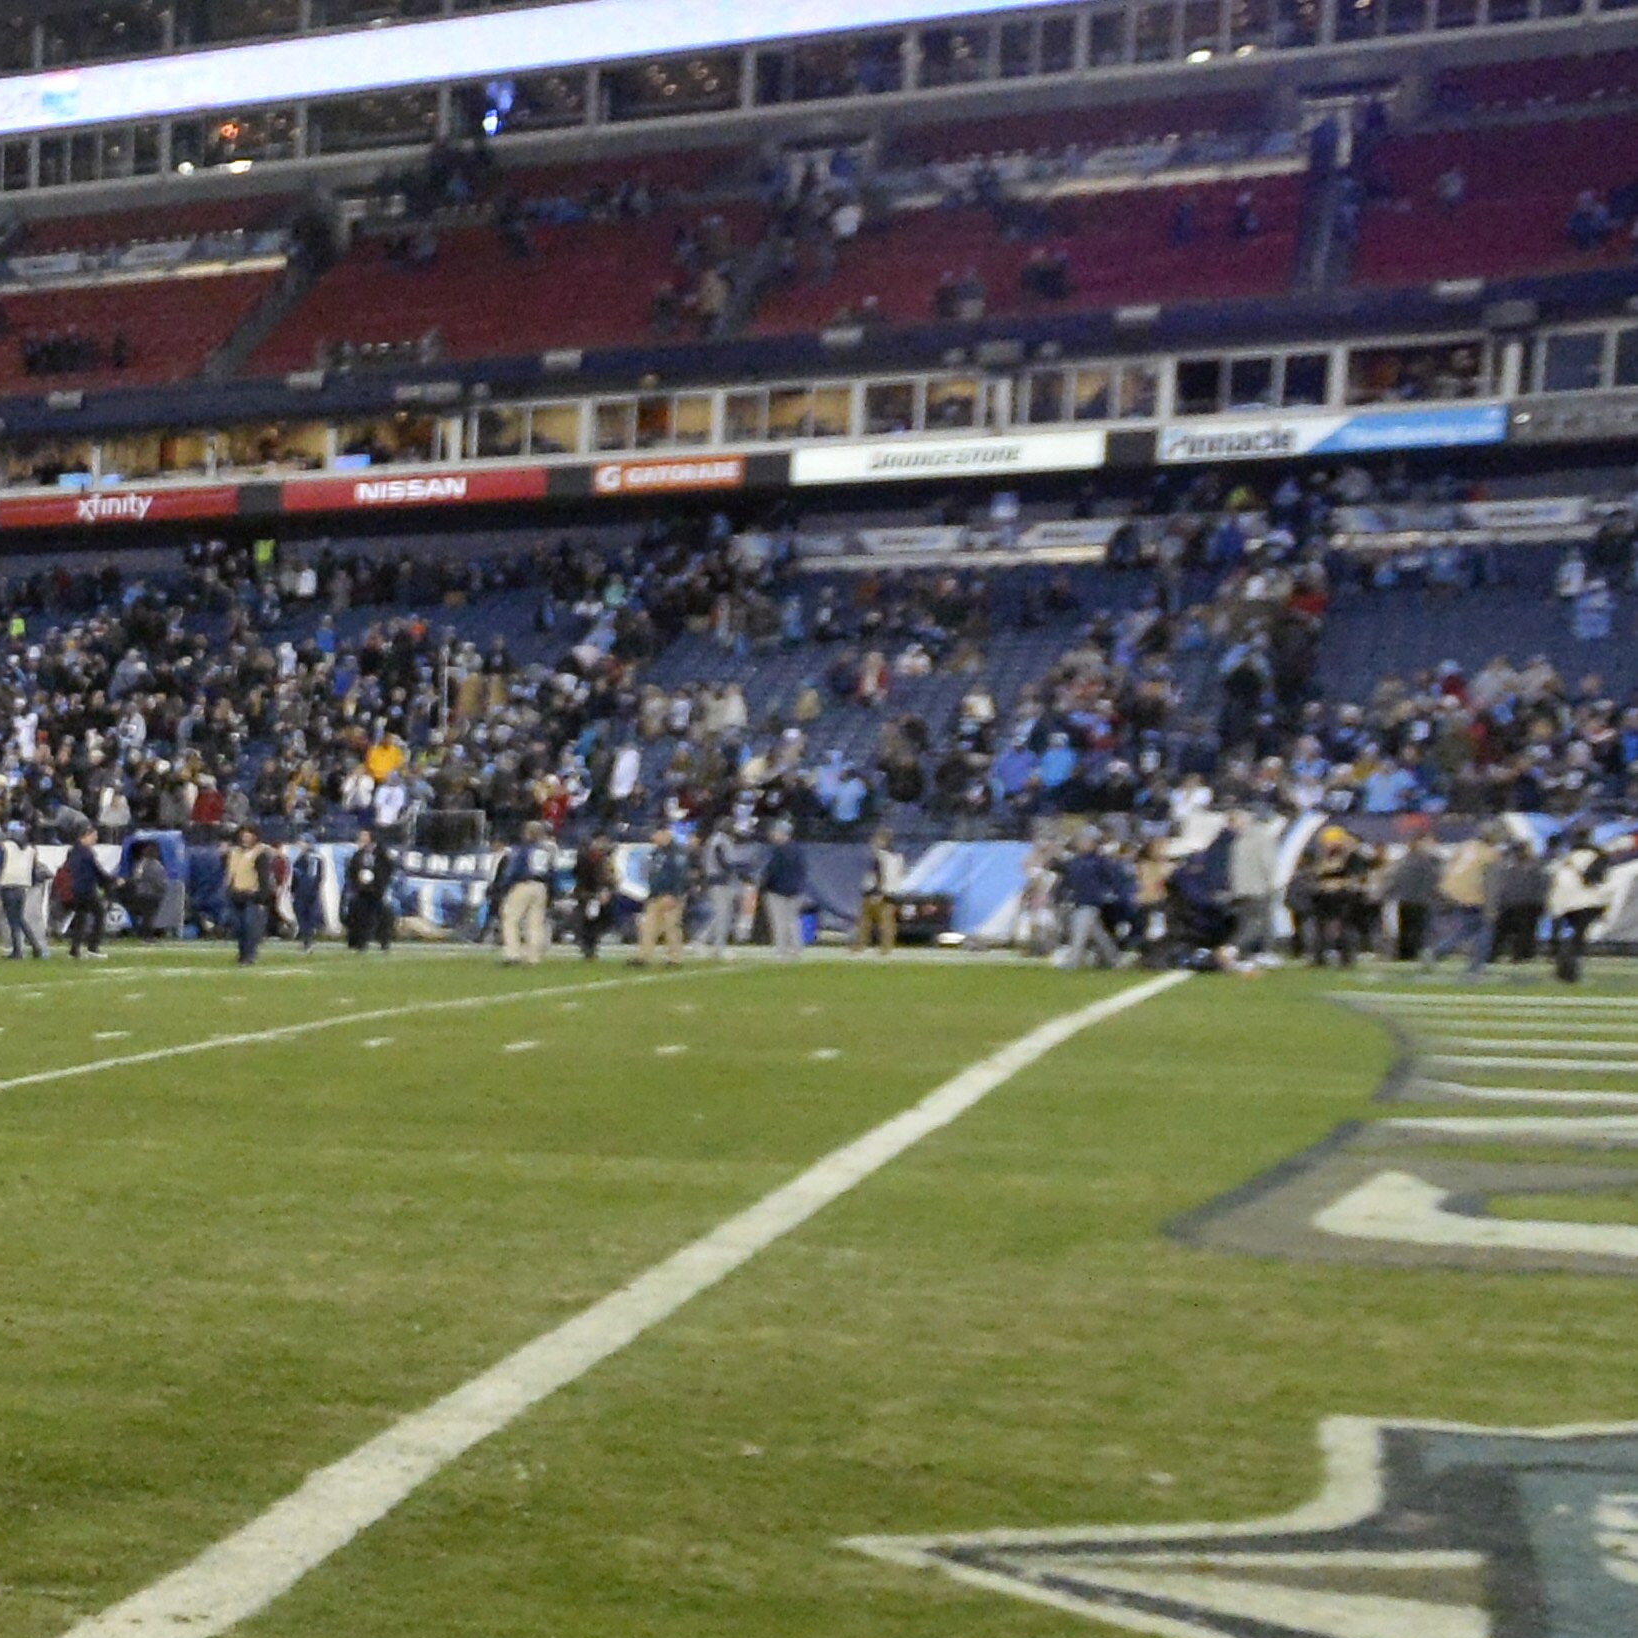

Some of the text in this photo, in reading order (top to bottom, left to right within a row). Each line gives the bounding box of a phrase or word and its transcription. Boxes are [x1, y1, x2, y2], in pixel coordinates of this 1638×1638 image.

[627, 461, 740, 485] GATORADE
[353, 477, 467, 504] NISSAN
[76, 493, 154, 523] xfinity
